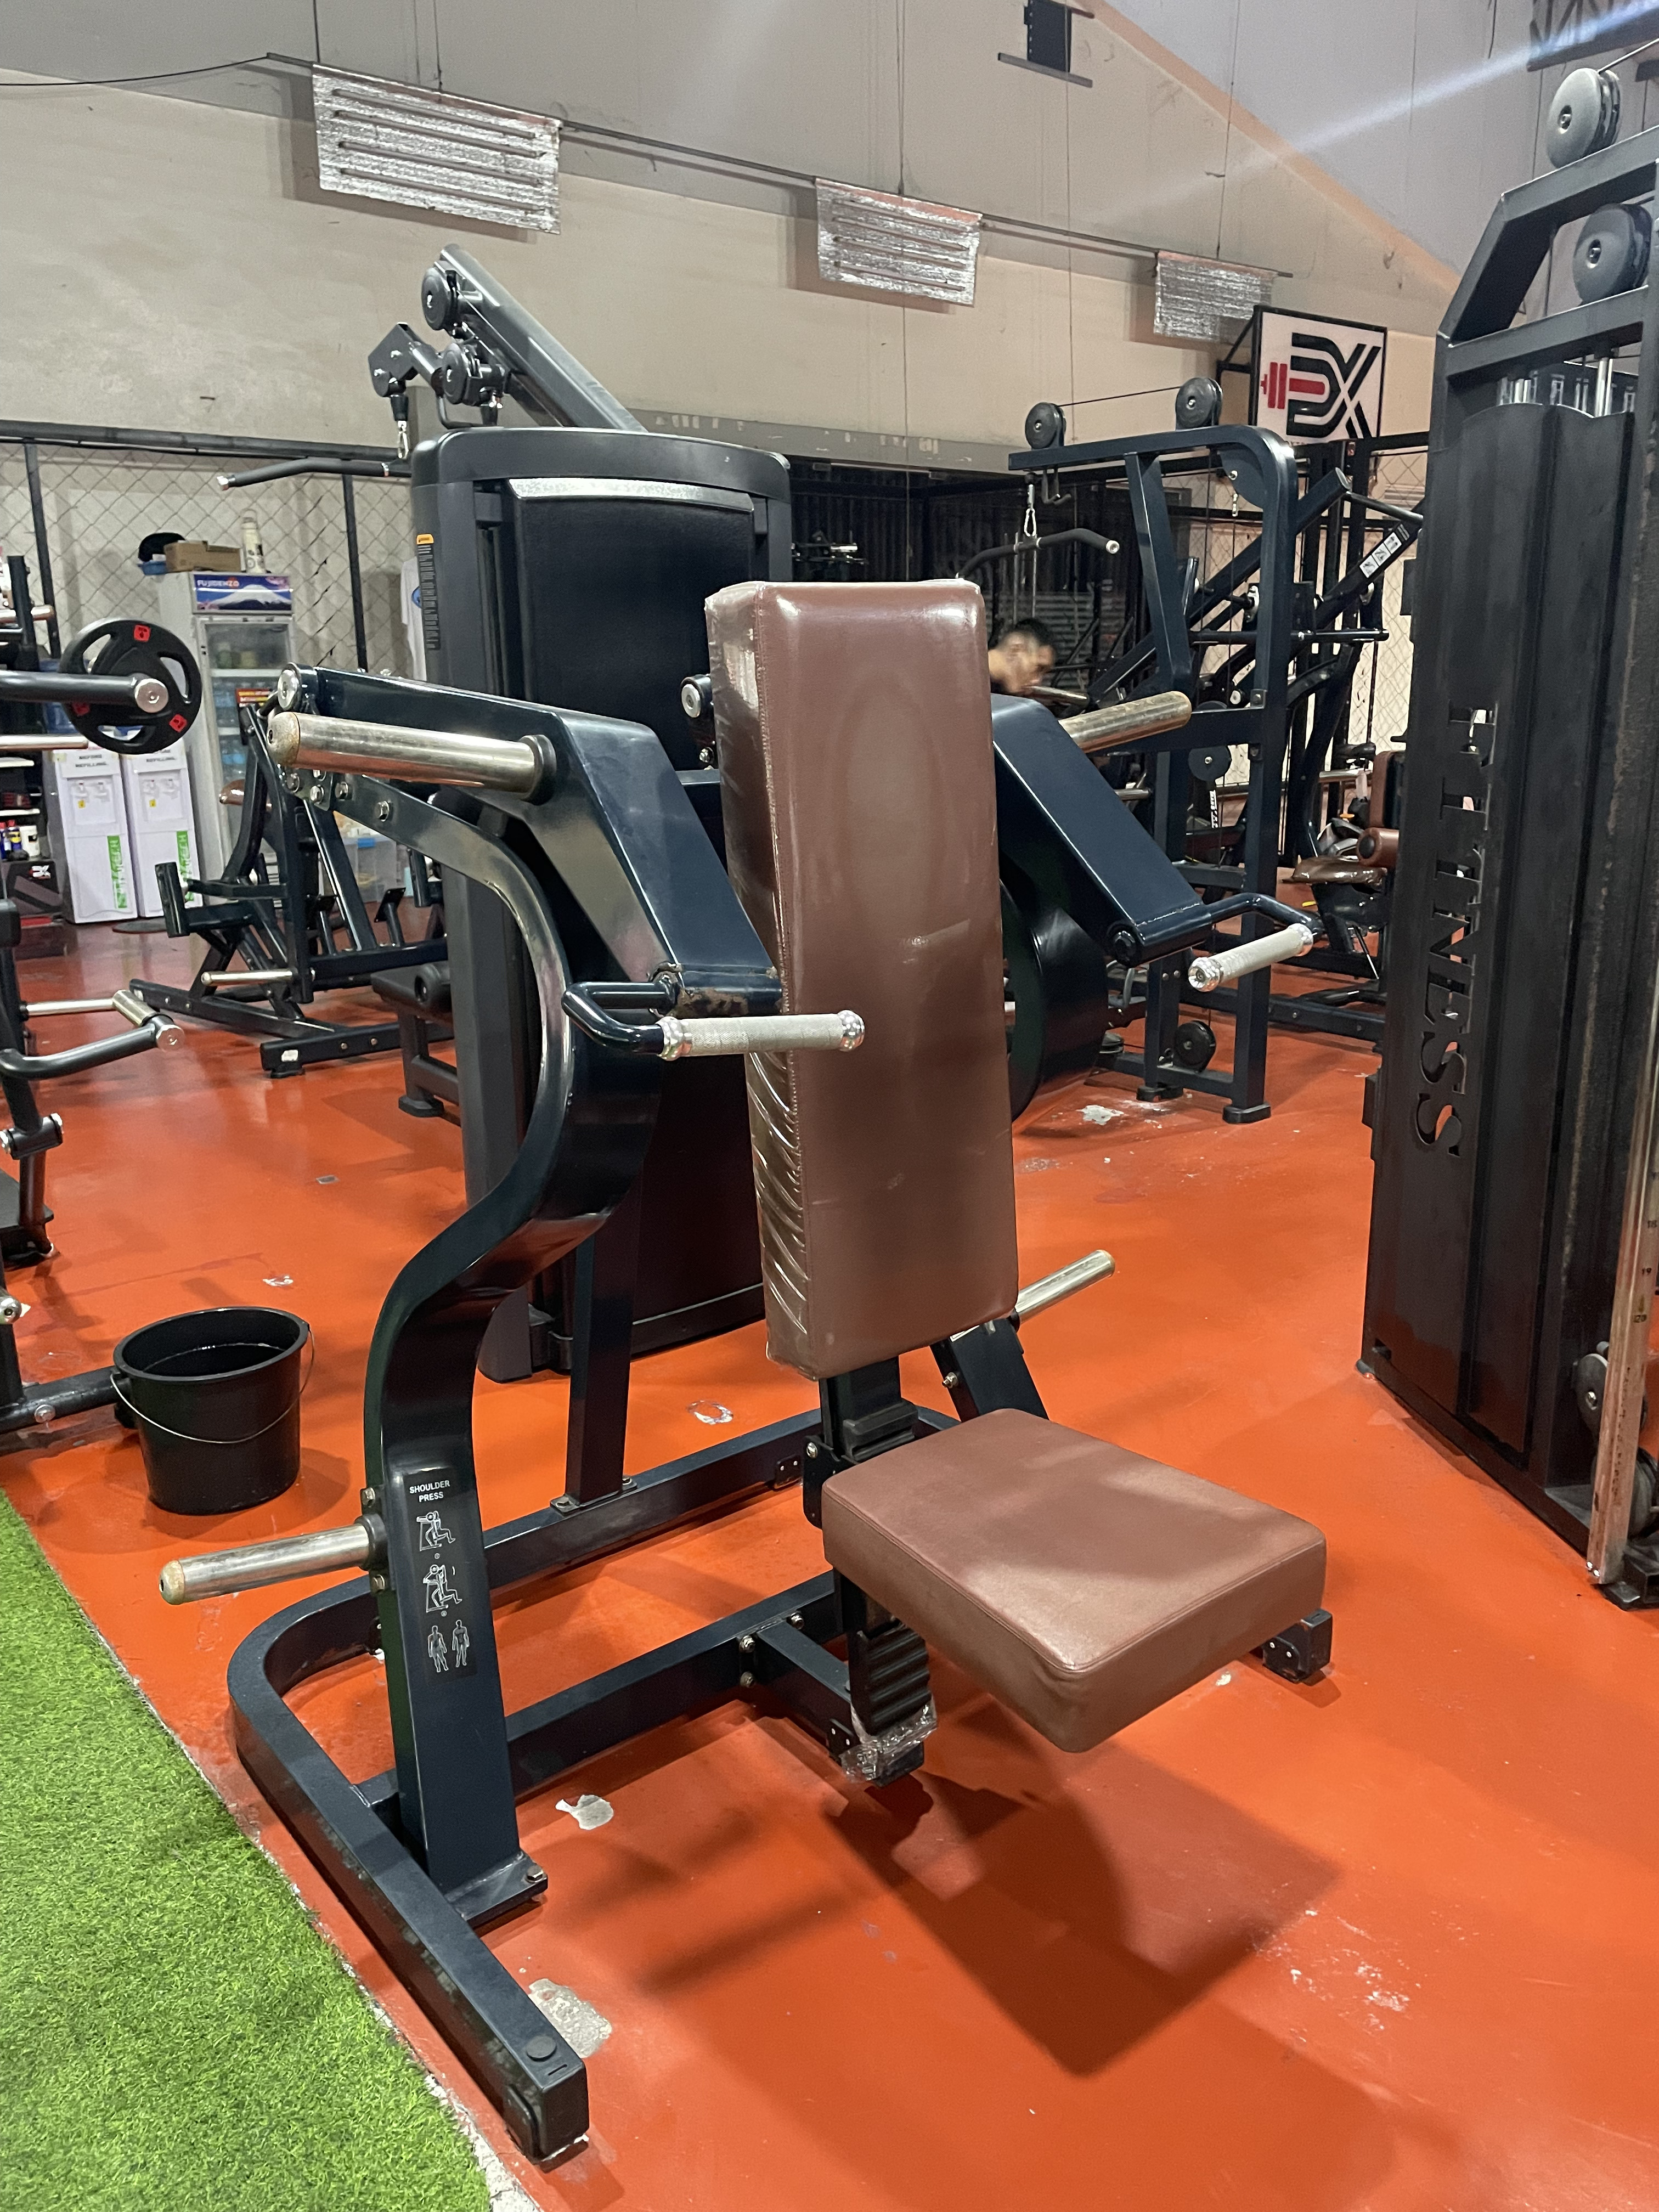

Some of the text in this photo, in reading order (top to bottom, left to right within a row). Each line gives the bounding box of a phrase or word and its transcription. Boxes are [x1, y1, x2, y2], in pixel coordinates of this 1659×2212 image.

[1414, 699, 1498, 1157] FITNESS
[409, 1480, 450, 1494] SHOULDER
[419, 1491, 444, 1503] PRESS
